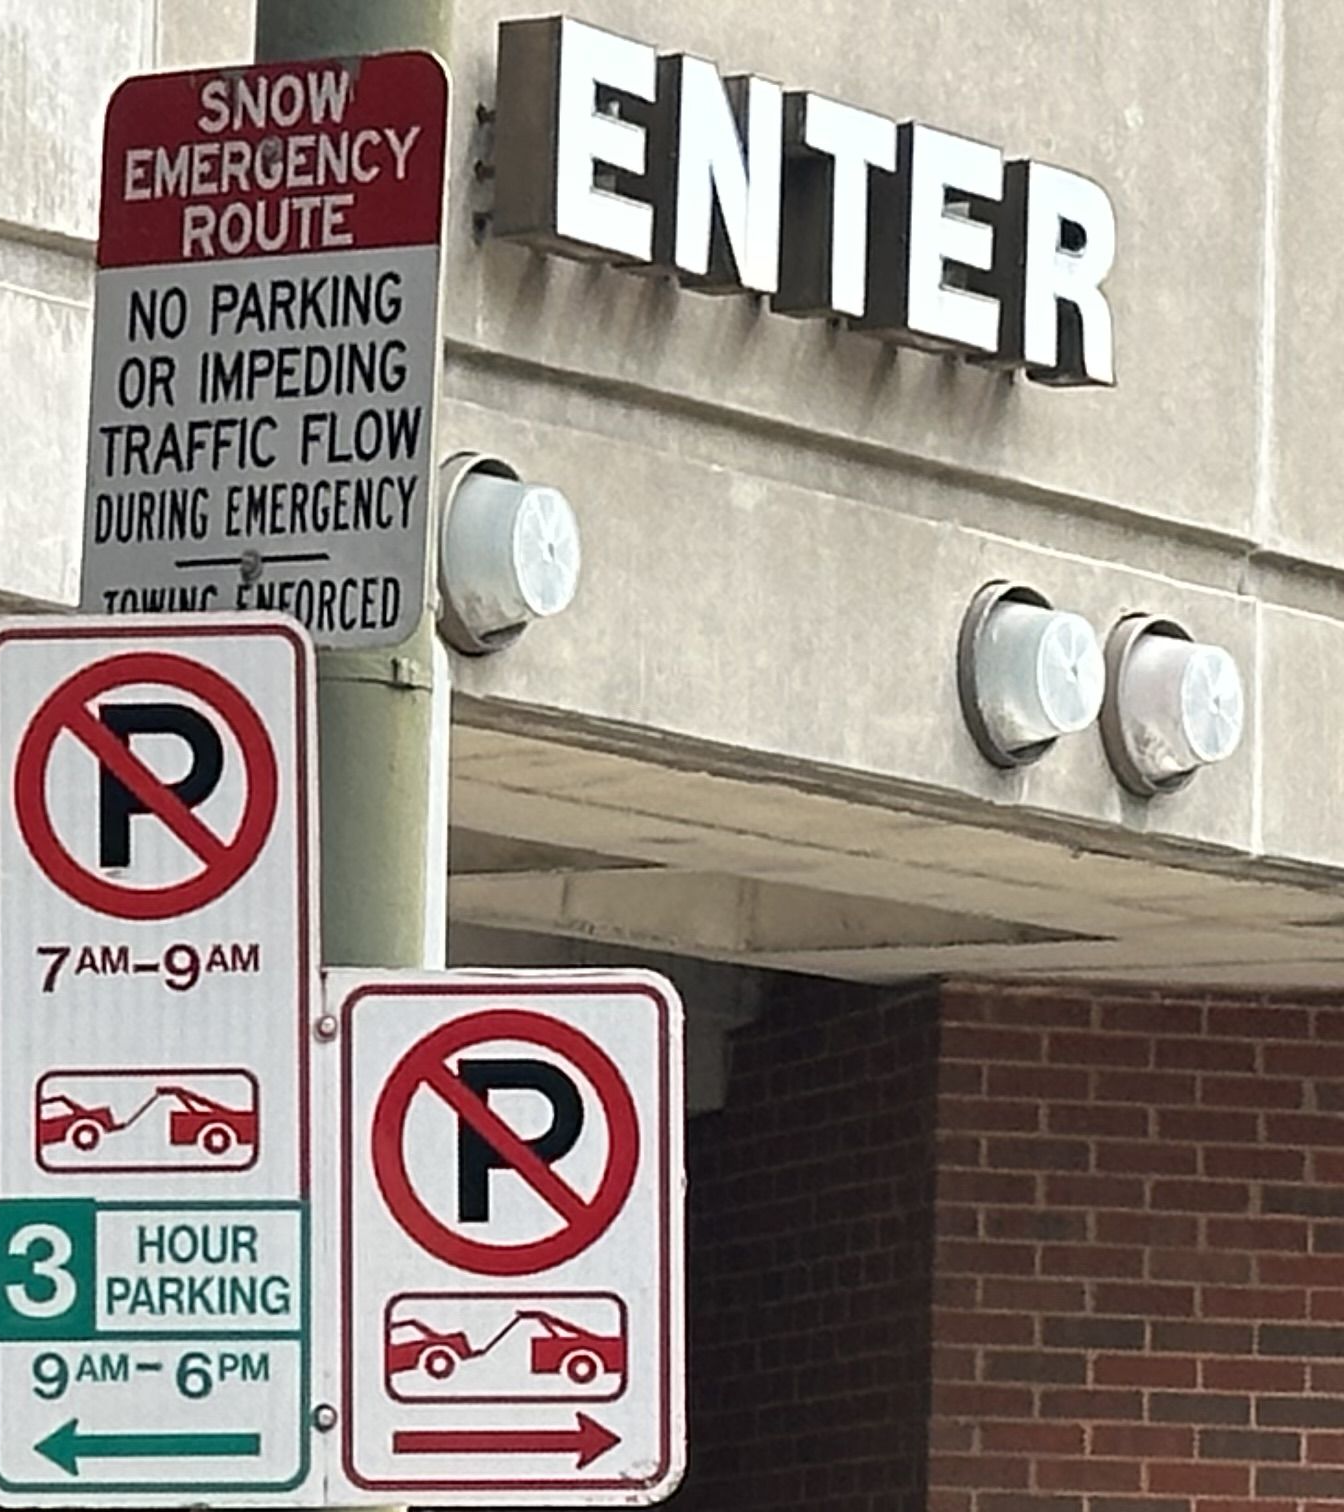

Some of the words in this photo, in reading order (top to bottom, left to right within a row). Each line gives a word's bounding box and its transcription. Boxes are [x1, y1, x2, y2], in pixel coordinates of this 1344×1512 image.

[197, 69, 353, 135] SNOW
[123, 125, 422, 201] EMERGENCY
[181, 194, 354, 257] ROUTE
[555, 15, 1116, 387] ENTER
[129, 286, 187, 341] NO
[211, 272, 402, 335] PARKING
[119, 356, 175, 409] OR
[200, 340, 406, 402] IMPEDING
[100, 415, 276, 476] TRAFFIC
[302, 406, 422, 466] FLOW
[95, 487, 209, 544] DURING
[226, 475, 418, 537] EMERGENCY
[236, 577, 400, 631] ENFORCED
[6, 1224, 76, 1317] 3
[137, 1224, 257, 1264] HOUR
[106, 1274, 291, 1317] PARKING
